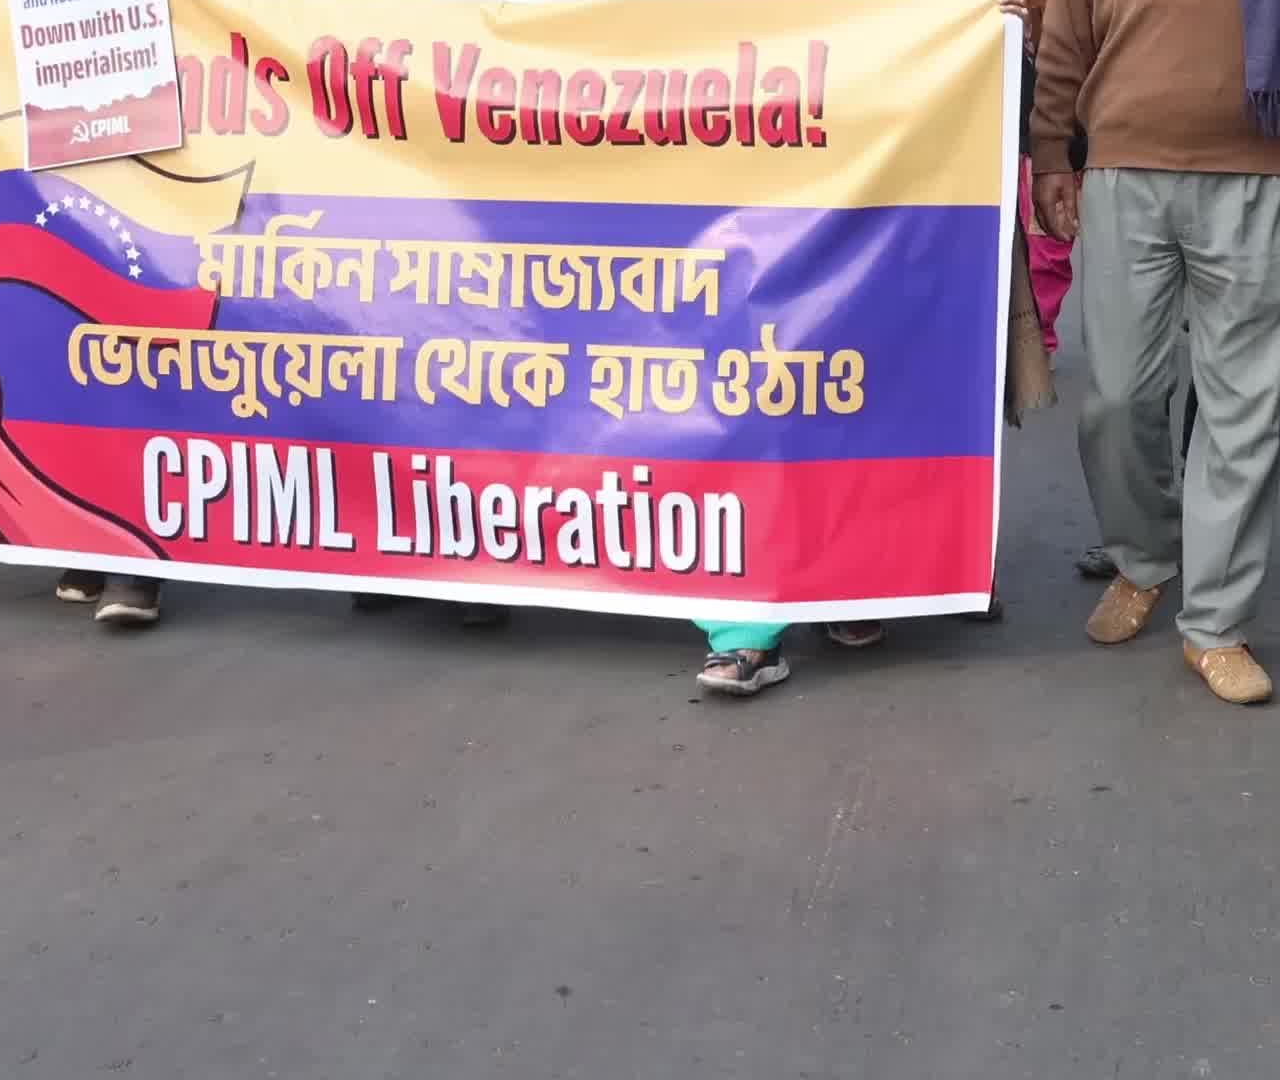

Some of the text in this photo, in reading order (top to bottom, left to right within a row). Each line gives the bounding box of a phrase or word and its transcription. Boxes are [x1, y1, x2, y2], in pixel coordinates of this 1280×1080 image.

[20, 2, 164, 50] Down with U.S.
[34, 41, 159, 88] imperialism!
[89, 115, 132, 137] CPIML
[176, 31, 830, 149] nds Off Venezuela!
[192, 209, 726, 317] মার্কিন সাম্রাজ্যবাদ
[67, 322, 866, 420] ভেনেজুয়েলা থেকে হাত ওঠাও
[142, 435, 746, 578] CPIML Liberation
